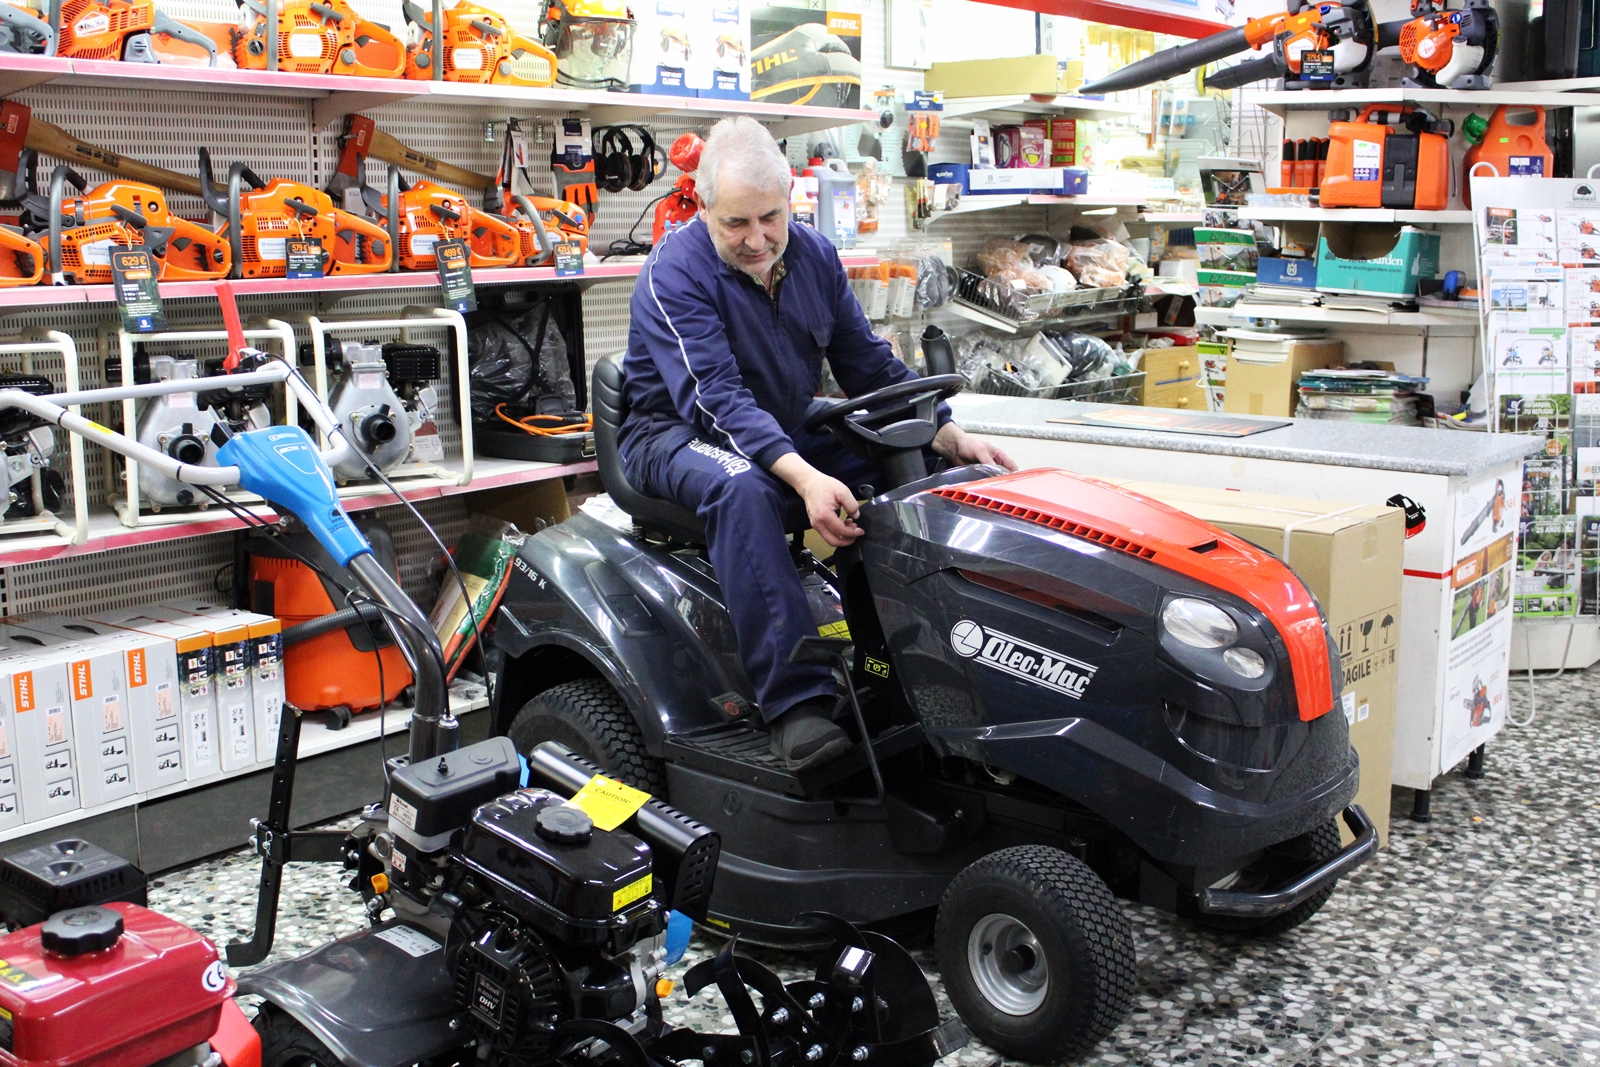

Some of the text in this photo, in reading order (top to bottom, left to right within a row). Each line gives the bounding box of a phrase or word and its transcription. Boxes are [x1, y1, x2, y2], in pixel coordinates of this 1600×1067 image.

[829, 18, 859, 30] STIHL
[121, 255, 147, 267] 629 €
[444, 248, 457, 257] 499
[688, 437, 739, 467] Husqvarna
[514, 557, 547, 590] 93/16 K
[133, 652, 143, 684] STIHL
[981, 636, 1092, 694] Oleo-Mac
[1342, 659, 1371, 686] RAGILE
[20, 675, 30, 709] STIHL
[78, 664, 88, 696] STIHL
[594, 787, 632, 805] CAUTION!
[206, 964, 225, 989] CE
[479, 995, 497, 1010] OHV
